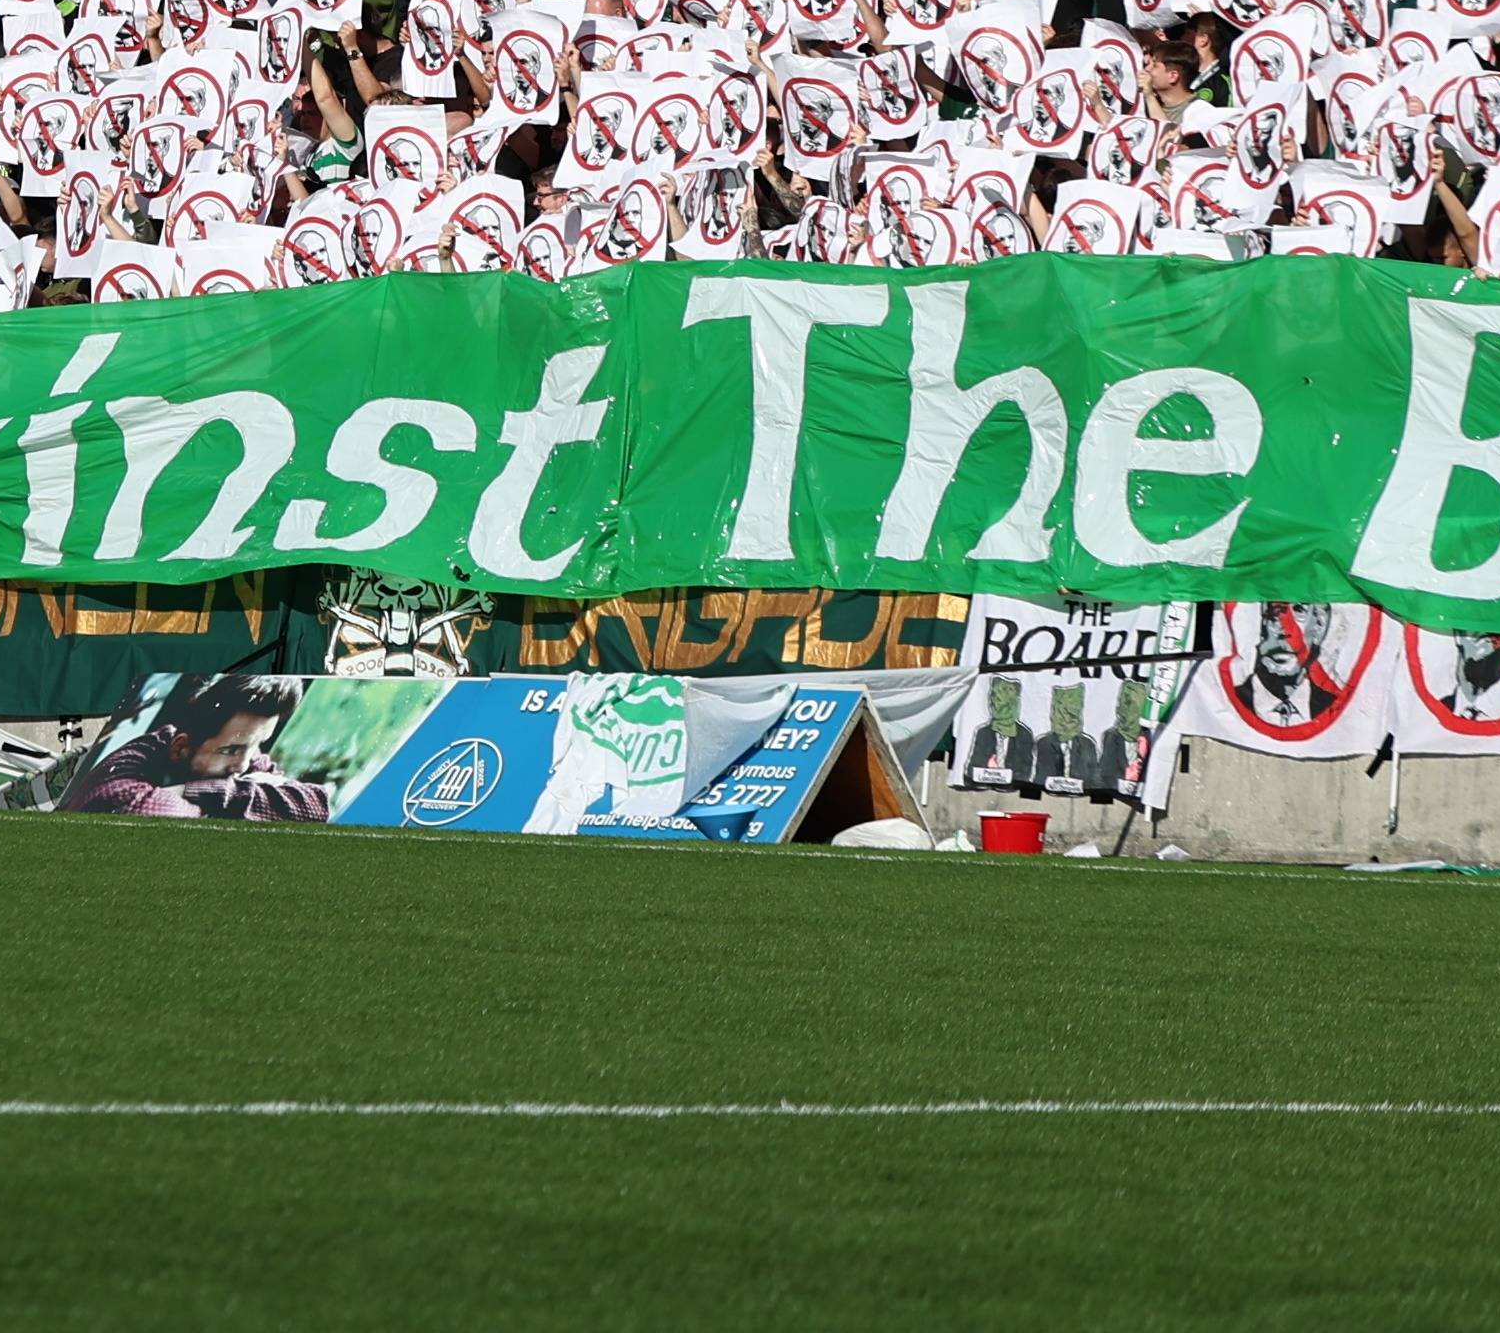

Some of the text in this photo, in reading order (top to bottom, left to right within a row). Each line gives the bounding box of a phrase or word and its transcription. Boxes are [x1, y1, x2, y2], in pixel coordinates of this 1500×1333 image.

[680, 275, 1266, 570] The
[1064, 600, 1113, 627] THE
[346, 657, 385, 676] 2006
[520, 689, 548, 711] IS
[784, 699, 838, 722] YOU
[724, 785, 786, 808] 2727
